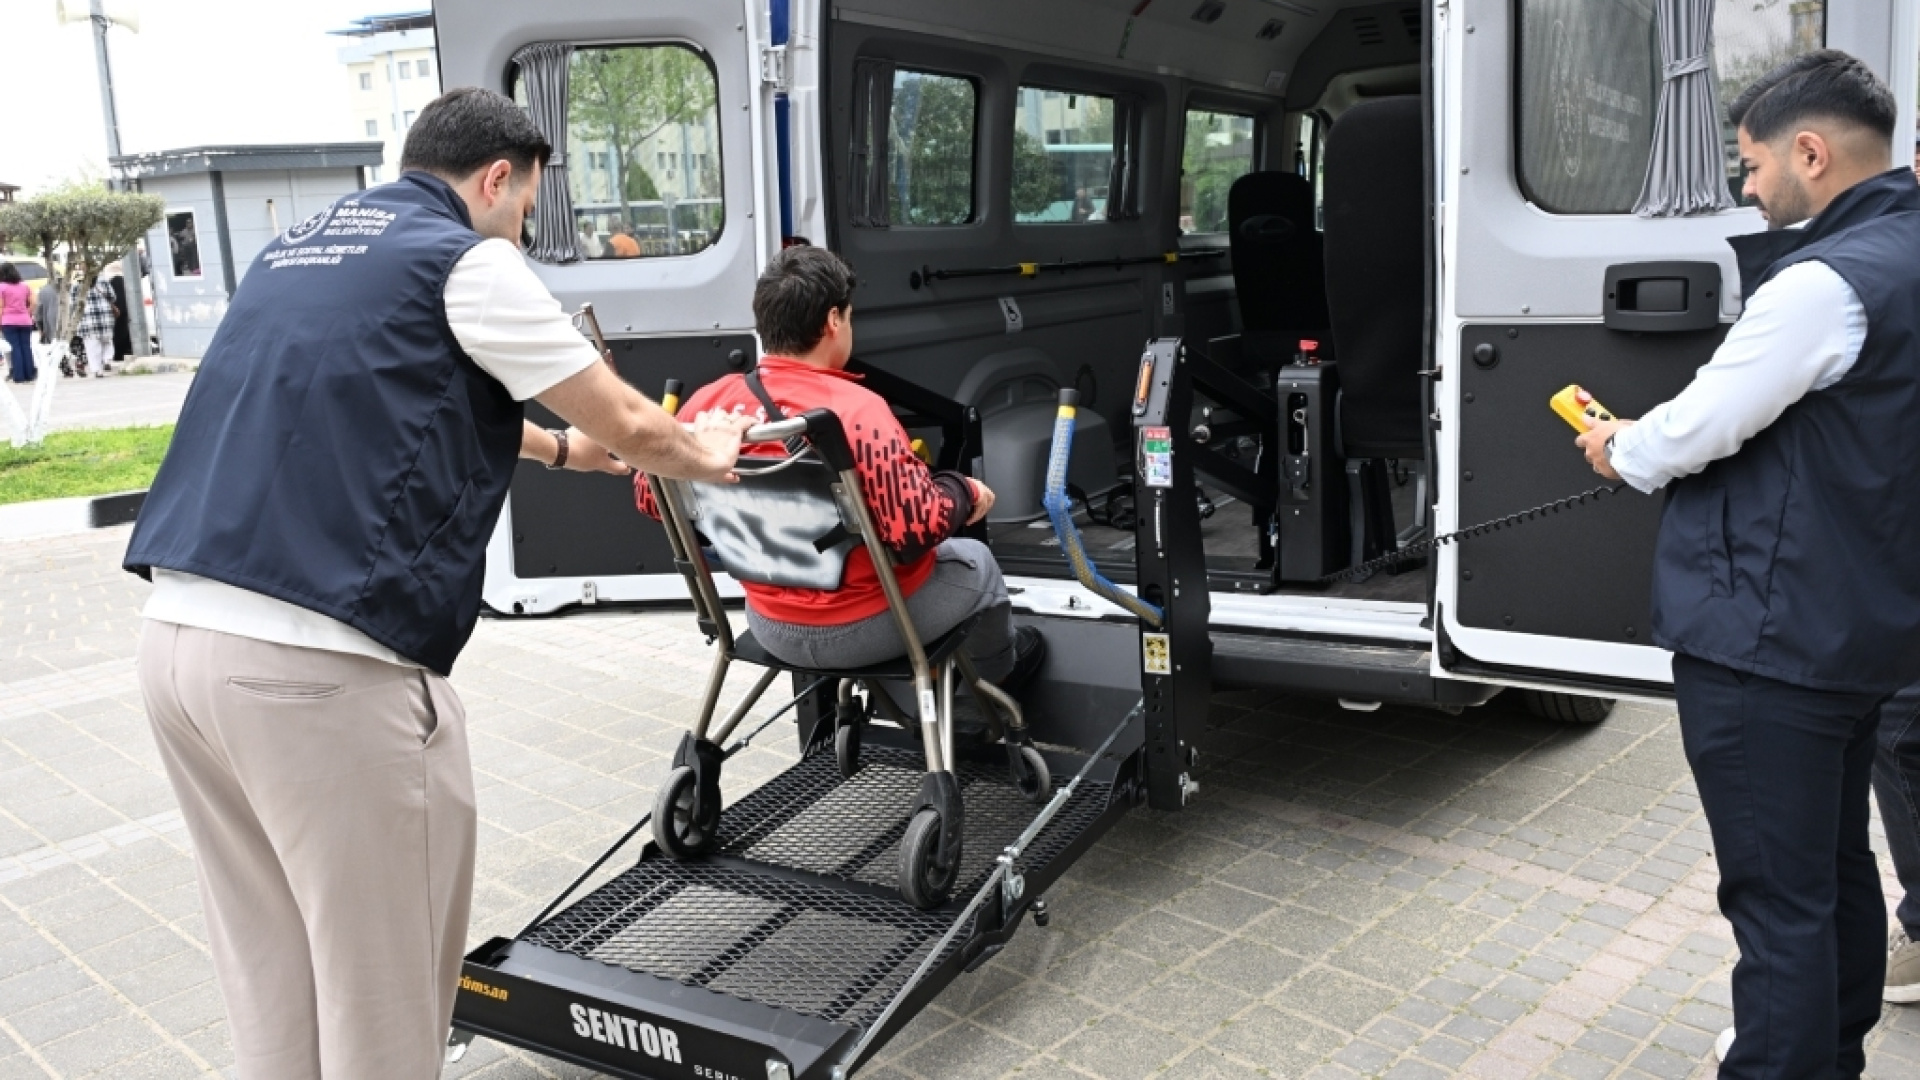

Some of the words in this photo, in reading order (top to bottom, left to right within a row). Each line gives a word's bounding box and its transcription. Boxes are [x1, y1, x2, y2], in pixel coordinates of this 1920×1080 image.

[335, 208, 397, 221] MANİSA
[322, 226, 384, 235] BELEDİYESİ
[569, 1003, 682, 1063] SENTOR
[693, 1064, 746, 1080] SERI
